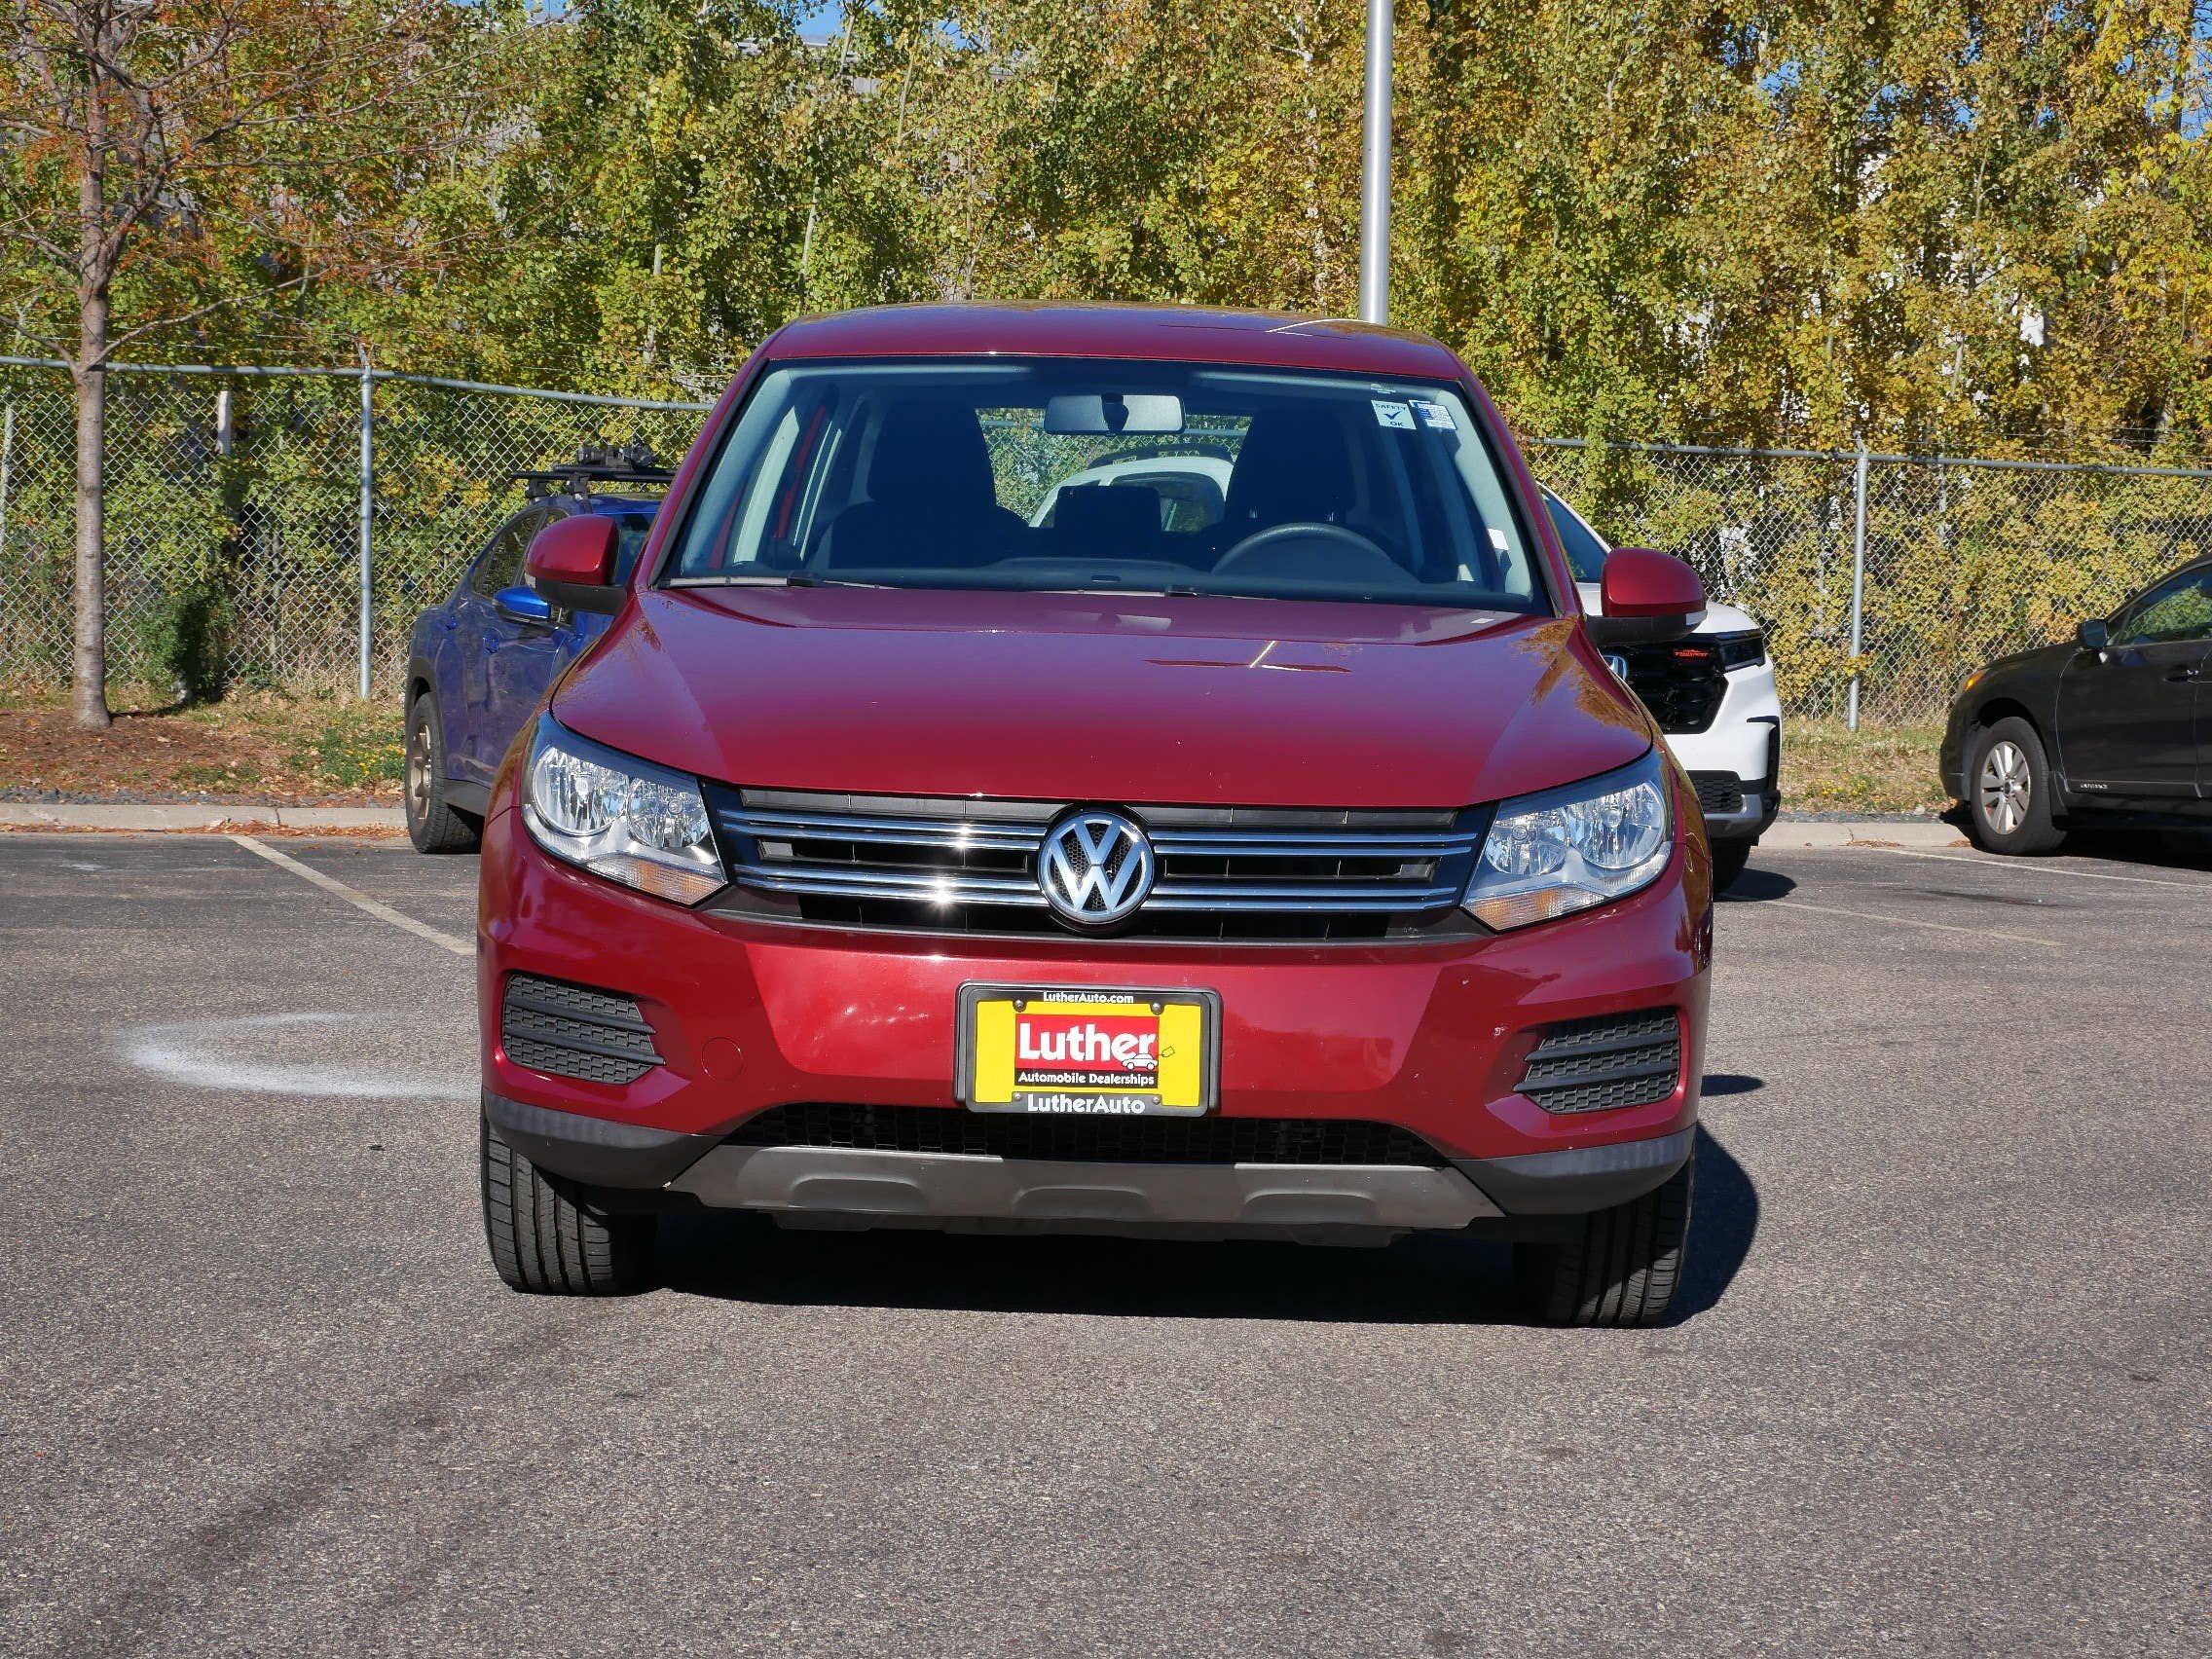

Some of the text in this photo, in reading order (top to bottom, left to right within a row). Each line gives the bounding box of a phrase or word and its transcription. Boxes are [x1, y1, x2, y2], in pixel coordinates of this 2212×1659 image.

[1043, 991, 1134, 1004] LutherAuto.com
[1018, 1022, 1157, 1062] Luther
[1018, 1072, 1155, 1086] Automobile Dealerships
[1027, 1093, 1146, 1114] LutherAuto
